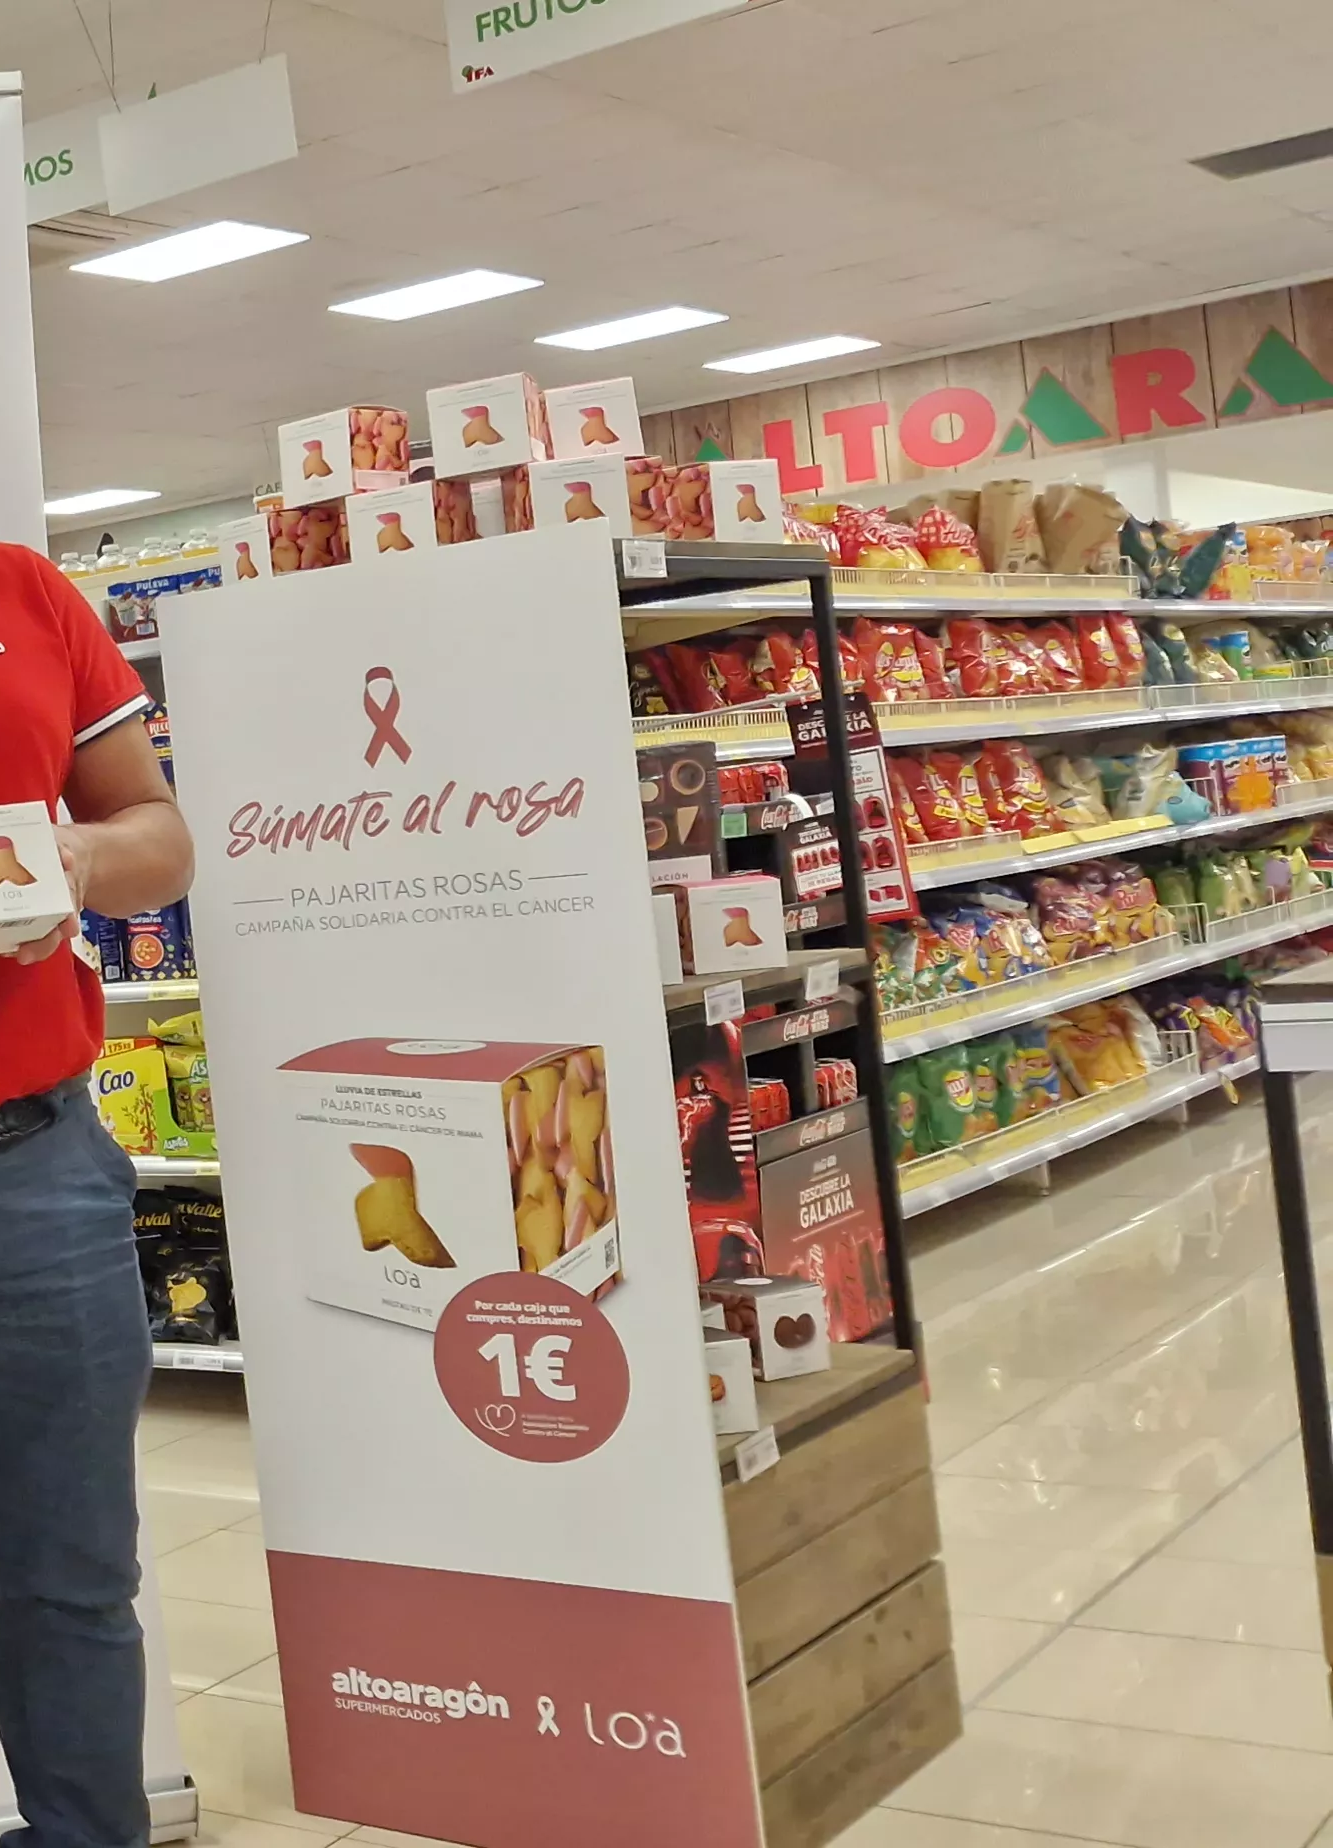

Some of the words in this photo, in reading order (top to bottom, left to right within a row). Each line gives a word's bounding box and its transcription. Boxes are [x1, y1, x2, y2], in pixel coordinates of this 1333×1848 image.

[136, 578, 170, 592] PULEVA
[226, 790, 393, 859] Súmate
[402, 780, 457, 835] al
[465, 777, 586, 837] rosa
[290, 877, 427, 908] PAJARITAS
[433, 868, 524, 897] ROSAS
[235, 915, 315, 937] CAMPAÑA
[319, 909, 409, 931] SOLIDARIA
[411, 904, 488, 924] CONTRA
[492, 902, 513, 918] EL
[517, 895, 595, 916] CÁNCER
[99, 1069, 135, 1096] Cao
[320, 1098, 391, 1116] PAJARITAS
[396, 1104, 447, 1121] ROSAS
[799, 1177, 840, 1206] DESCUBRE
[840, 1173, 851, 1189] LA
[800, 1189, 854, 1229] GALAXIA
[466, 1313, 516, 1325] compres,
[517, 1314, 583, 1327] destinamos
[475, 1300, 494, 1310] Por
[495, 1301, 522, 1312] cada
[523, 1302, 547, 1315] caja
[549, 1304, 570, 1316] que
[477, 1333, 577, 1402] 1€
[335, 1697, 442, 1724] SUPERMERCADOS
